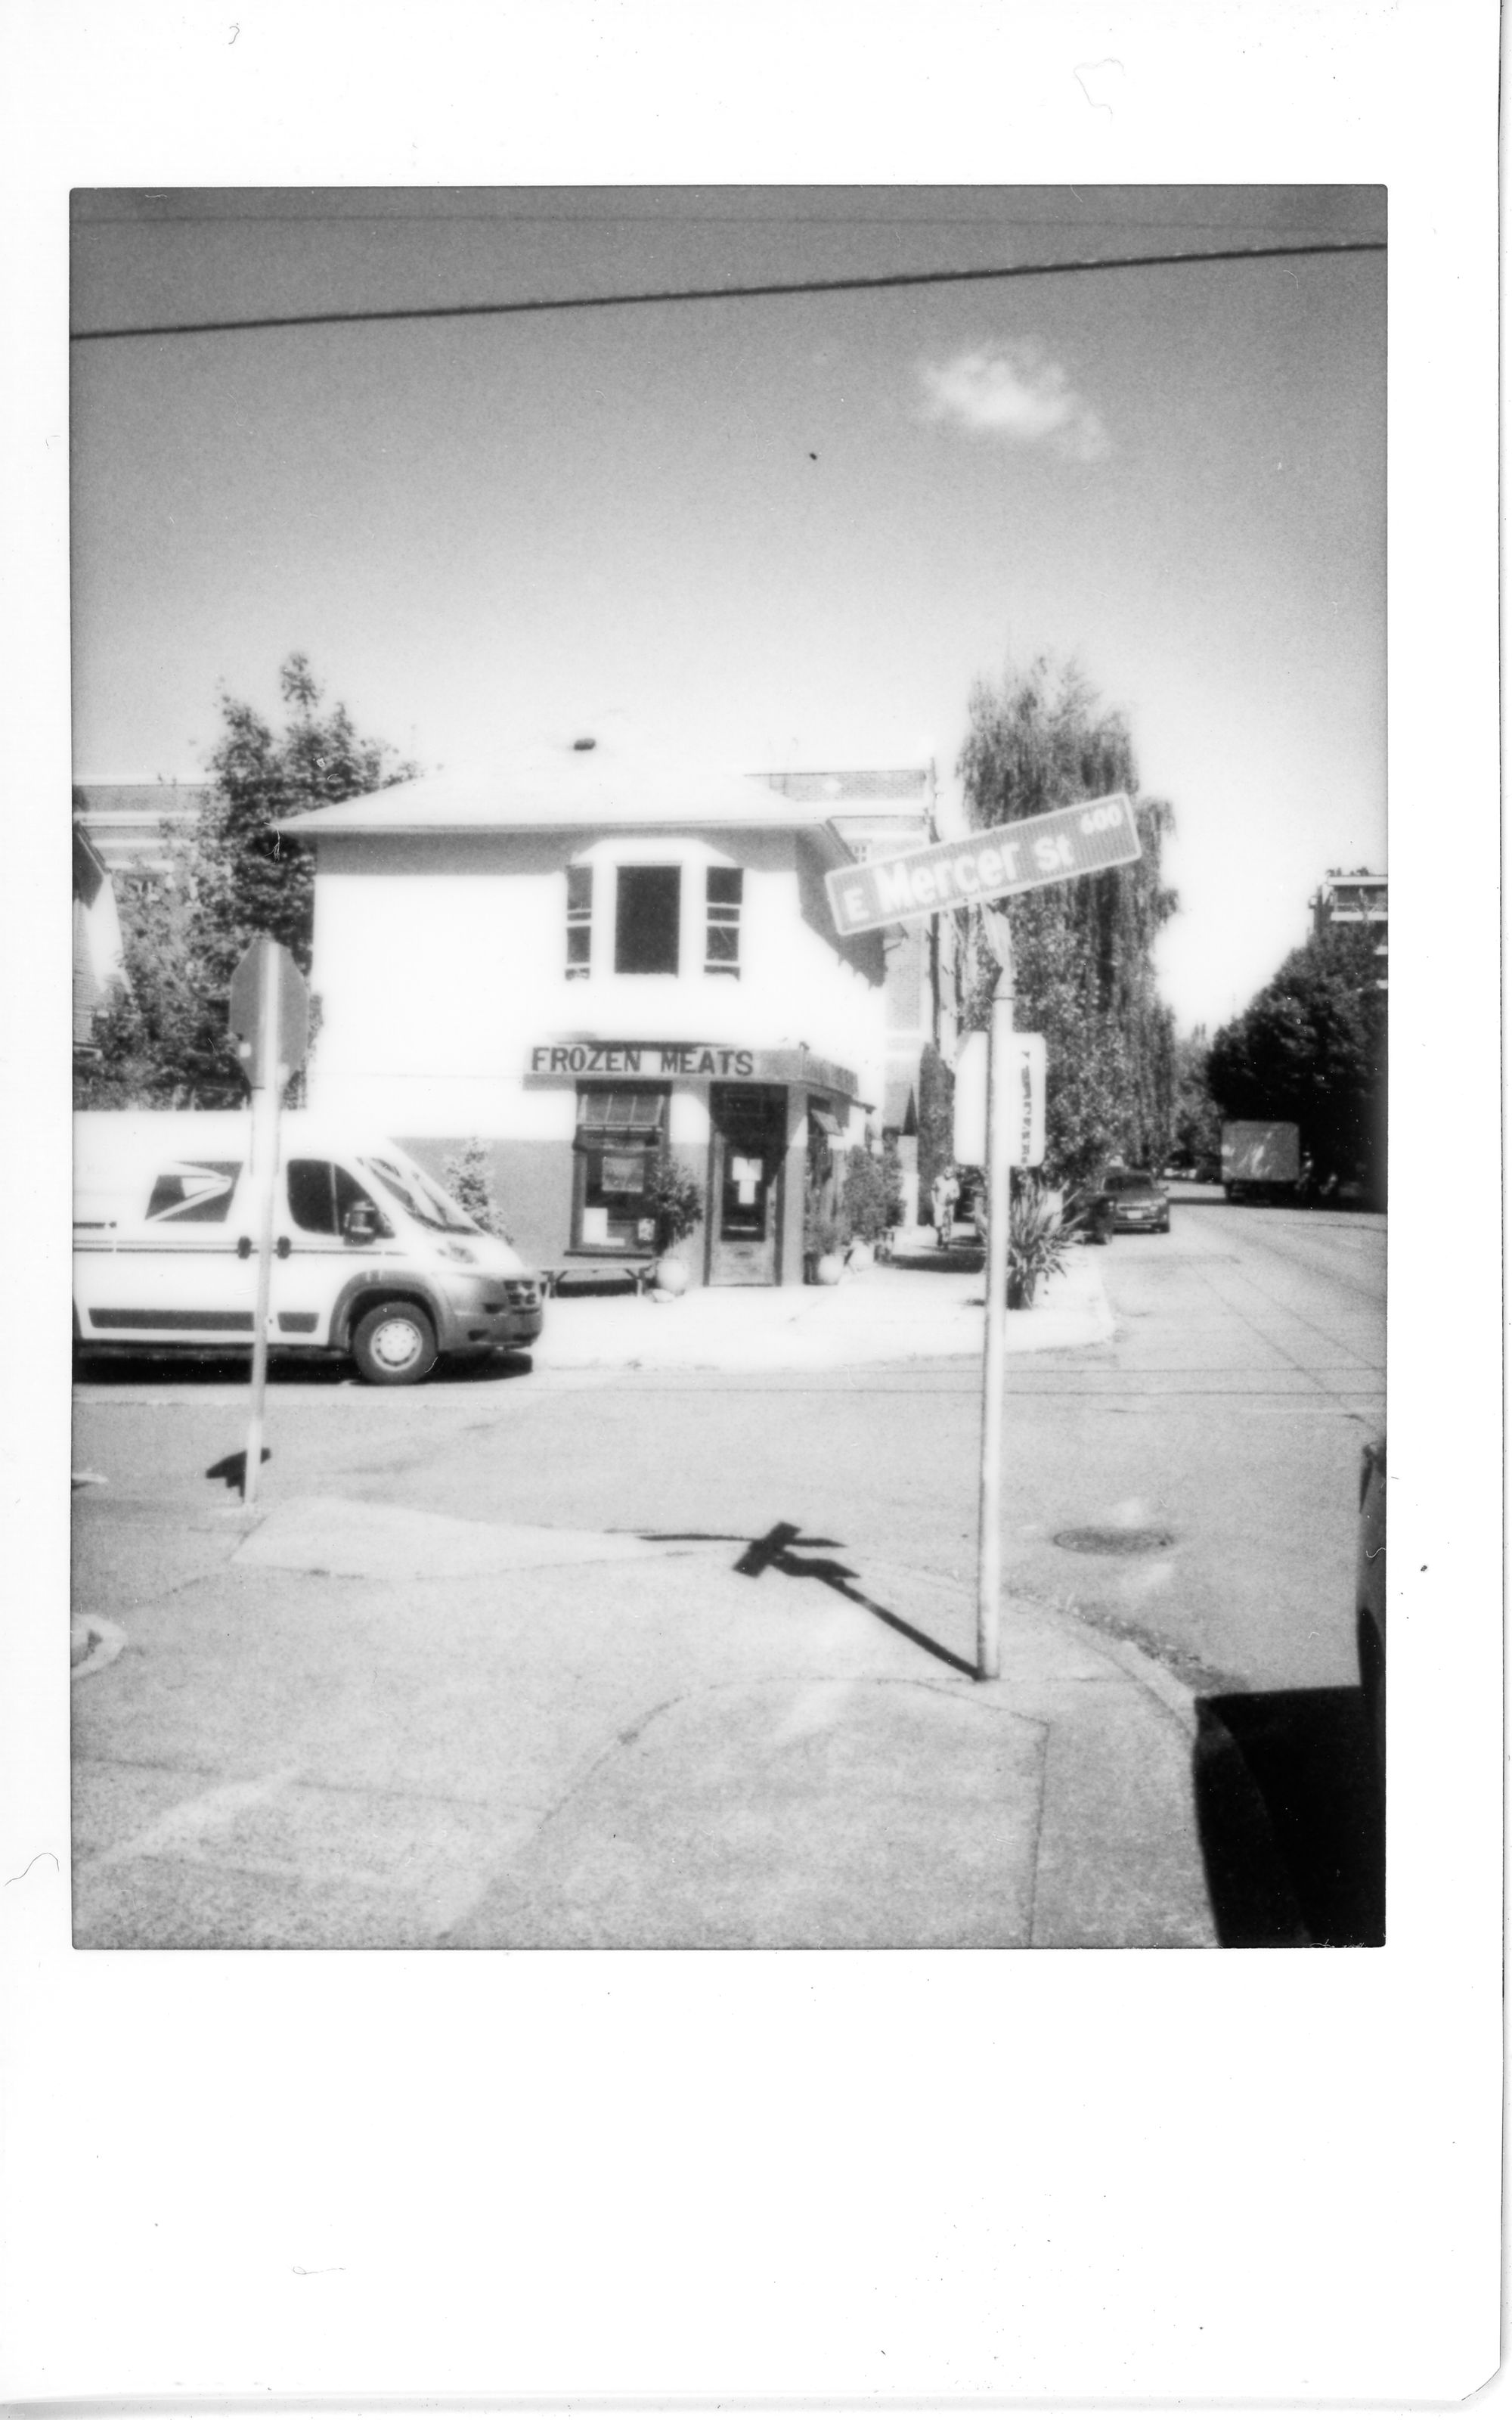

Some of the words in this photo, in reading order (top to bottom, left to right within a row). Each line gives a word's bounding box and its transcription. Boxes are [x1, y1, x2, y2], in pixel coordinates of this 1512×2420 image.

[1080, 805, 1123, 835] 600
[842, 887, 870, 922] E
[873, 841, 1021, 913] Mercer
[1033, 833, 1075, 871] St
[531, 1046, 641, 1072] FROZEN
[660, 1048, 754, 1077] MEATS
